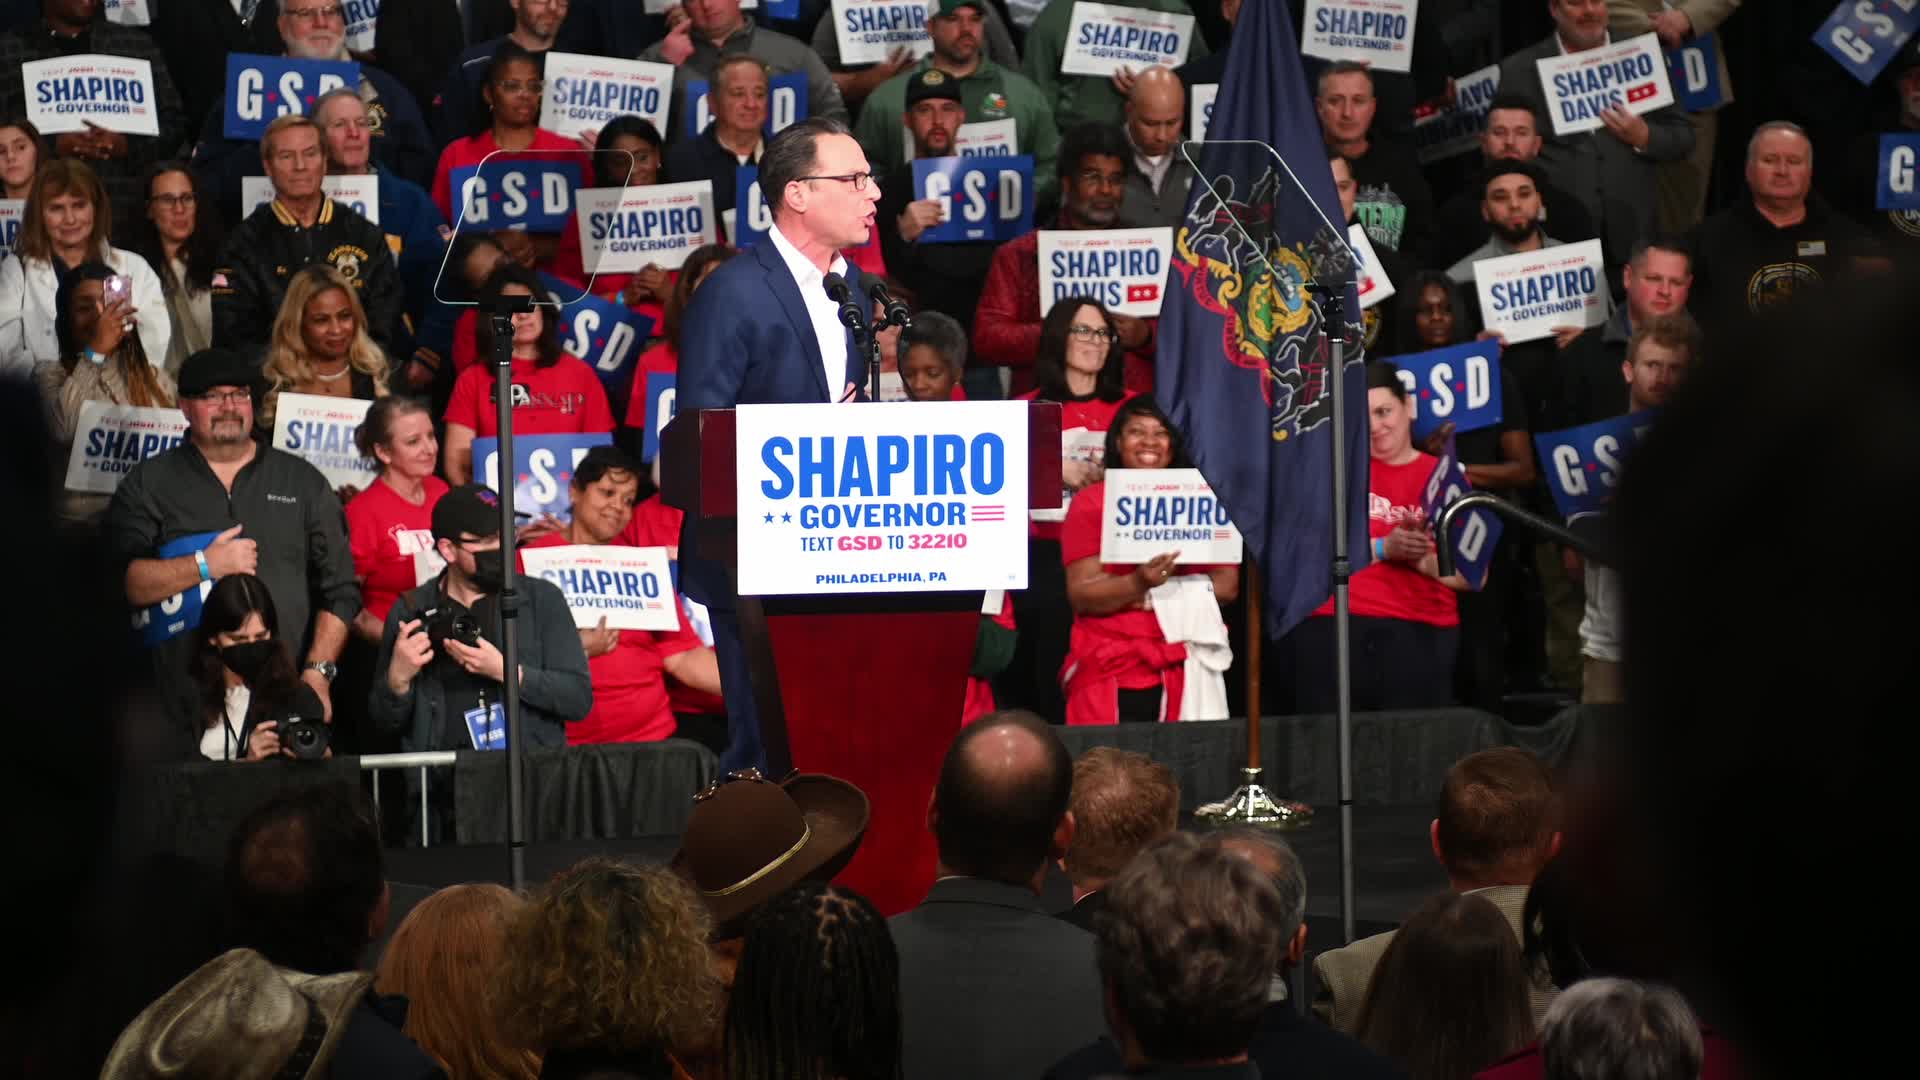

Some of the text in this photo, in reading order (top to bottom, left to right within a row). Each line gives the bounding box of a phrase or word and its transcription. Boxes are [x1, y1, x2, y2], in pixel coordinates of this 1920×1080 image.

[845, 5, 928, 32] SHAPIR
[1315, 7, 1408, 40] SHAPIRO
[1079, 22, 1179, 54] SHAPIRO
[1328, 35, 1392, 50] GOVERNOR
[1091, 47, 1159, 63] GOVERNOR
[1553, 52, 1653, 97] SHAPIRO
[36, 77, 145, 103] SHAPIRO
[552, 75, 660, 114] SHAPIRO
[56, 103, 130, 113] GOVERNOR
[1560, 89, 1623, 122] DAVIS
[590, 206, 703, 240] SHAPIRO
[610, 237, 687, 252] GOVERNOR
[1051, 248, 1160, 278] SHAPIRO
[1491, 265, 1595, 311] SHAPIRO
[1512, 299, 1583, 320] GOVERNOR
[286, 419, 355, 455] SHAP
[760, 432, 1005, 500] SHAPIRO
[800, 502, 966, 529] GOVERNOR
[1116, 496, 1231, 526] SHAPIRO
[801, 533, 967, 551] TEXT GSD TO 32210
[1133, 528, 1212, 541] GOVERNOR
[816, 571, 947, 585] PHILADELPHIA, PA
